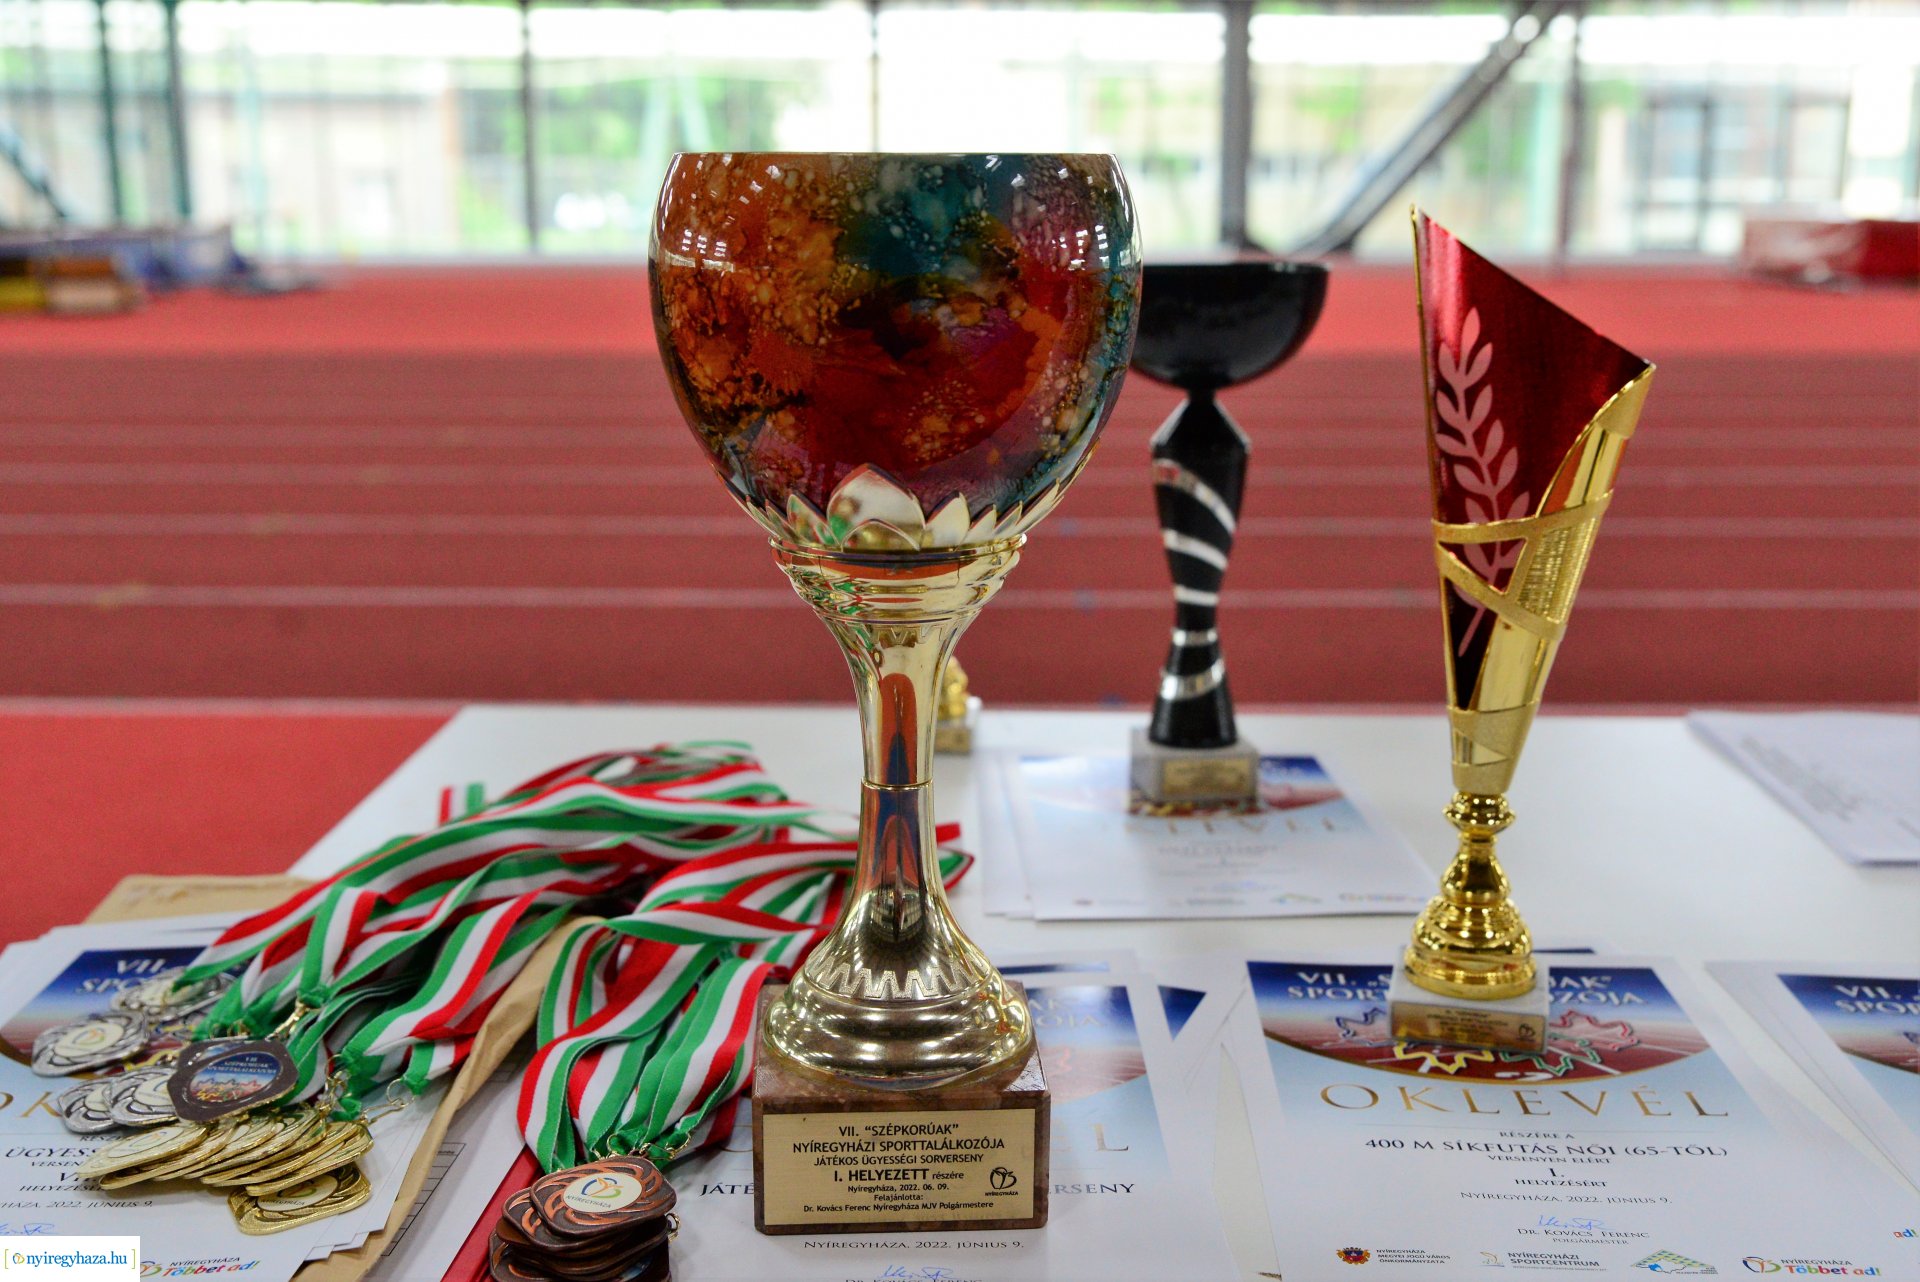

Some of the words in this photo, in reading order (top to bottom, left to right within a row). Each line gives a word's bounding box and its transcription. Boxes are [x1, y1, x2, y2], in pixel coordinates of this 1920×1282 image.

[1298, 971, 1356, 985] VII.
[1834, 984, 1901, 1000] VII.
[1320, 1083, 1729, 1117] OKLEVÉL
[839, 1126, 859, 1137] VII.
[793, 1139, 876, 1153] NYÍREGYHÁZI
[879, 1136, 1005, 1152] SPORTTALÁLKOZÓJA
[1365, 1139, 1405, 1149] 400
[1413, 1140, 1434, 1150] M
[1443, 1139, 1558, 1155] SÍKFUTÁS
[1566, 1144, 1617, 1156] NŐI
[1624, 1144, 1728, 1157] (65-TŐL)
[814, 1154, 859, 1166] JÁTÉKOS
[862, 1153, 917, 1166] ÜGYESSÉGI
[920, 1153, 984, 1164] SORVERSENY
[1487, 1155, 1567, 1164] VERSENYEN
[834, 1170, 843, 1182] I.
[848, 1168, 930, 1182] HELYEZETT
[932, 1171, 965, 1180] részére
[1549, 1167, 1565, 1178] I.
[847, 1183, 897, 1193] Nyíregyháza,
[900, 1184, 920, 1192] 2022.
[923, 1183, 935, 1191] 06.
[938, 1183, 950, 1191] 09.
[1515, 1179, 1608, 1188] HELYEZÉSÉRT
[874, 1193, 924, 1202] Felajánlotta:
[816, 1203, 843, 1212] Kovács
[873, 1202, 920, 1212] Nyíregyháza
[940, 1201, 994, 1211] Polgármestere
[1544, 1229, 1593, 1237] KOVÁCS
[915, 1241, 951, 1249] 2022.
[1012, 1240, 1025, 1249] 9.
[1507, 1251, 1580, 1260] NYÍREGYHÁZI
[1510, 1258, 1600, 1267] SPORTCENTRUM
[162, 1263, 225, 1277] Többet
[1784, 1264, 1849, 1275] Többet
[1853, 1266, 1882, 1276] ad!
